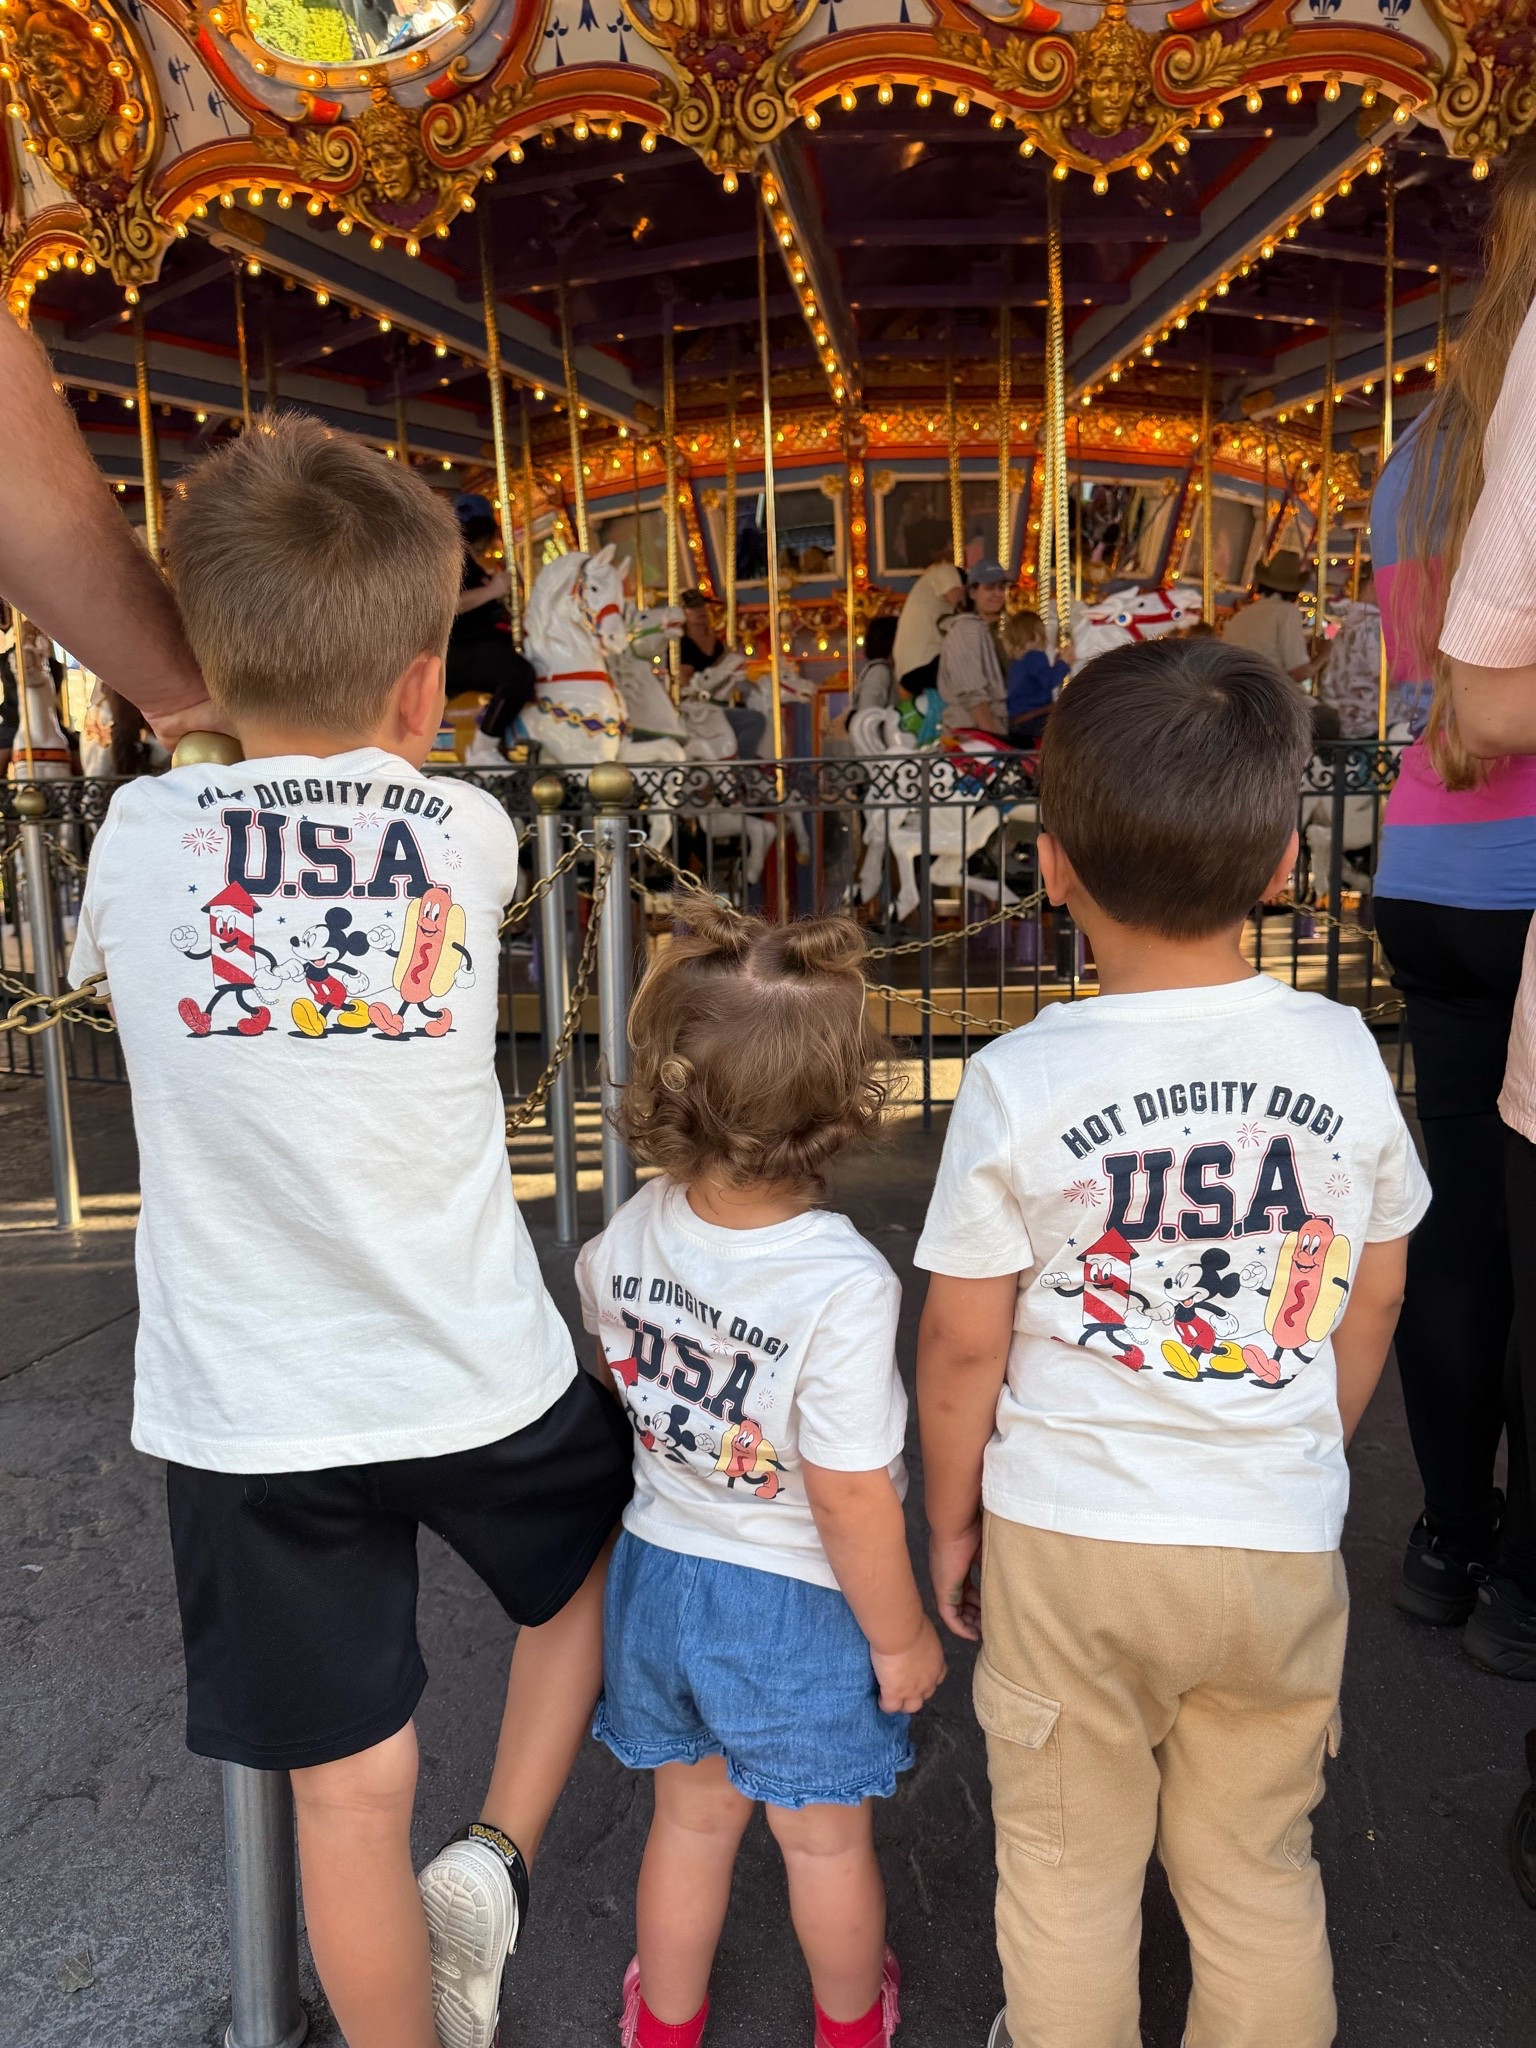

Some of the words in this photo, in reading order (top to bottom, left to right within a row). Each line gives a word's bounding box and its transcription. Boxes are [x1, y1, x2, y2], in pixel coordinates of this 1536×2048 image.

[253, 778, 373, 810] DIGGITY
[381, 784, 453, 825] DOG!
[221, 808, 451, 899] U.S.A
[1060, 1103, 1127, 1160] HOT
[1132, 1081, 1258, 1127] DIGGITY
[1264, 1085, 1344, 1143] DOG!
[1102, 1134, 1333, 1242] U.S.A
[648, 1278, 722, 1331] DIGGITY
[729, 1316, 789, 1363] DOG!
[621, 1308, 762, 1429] U.S.A
